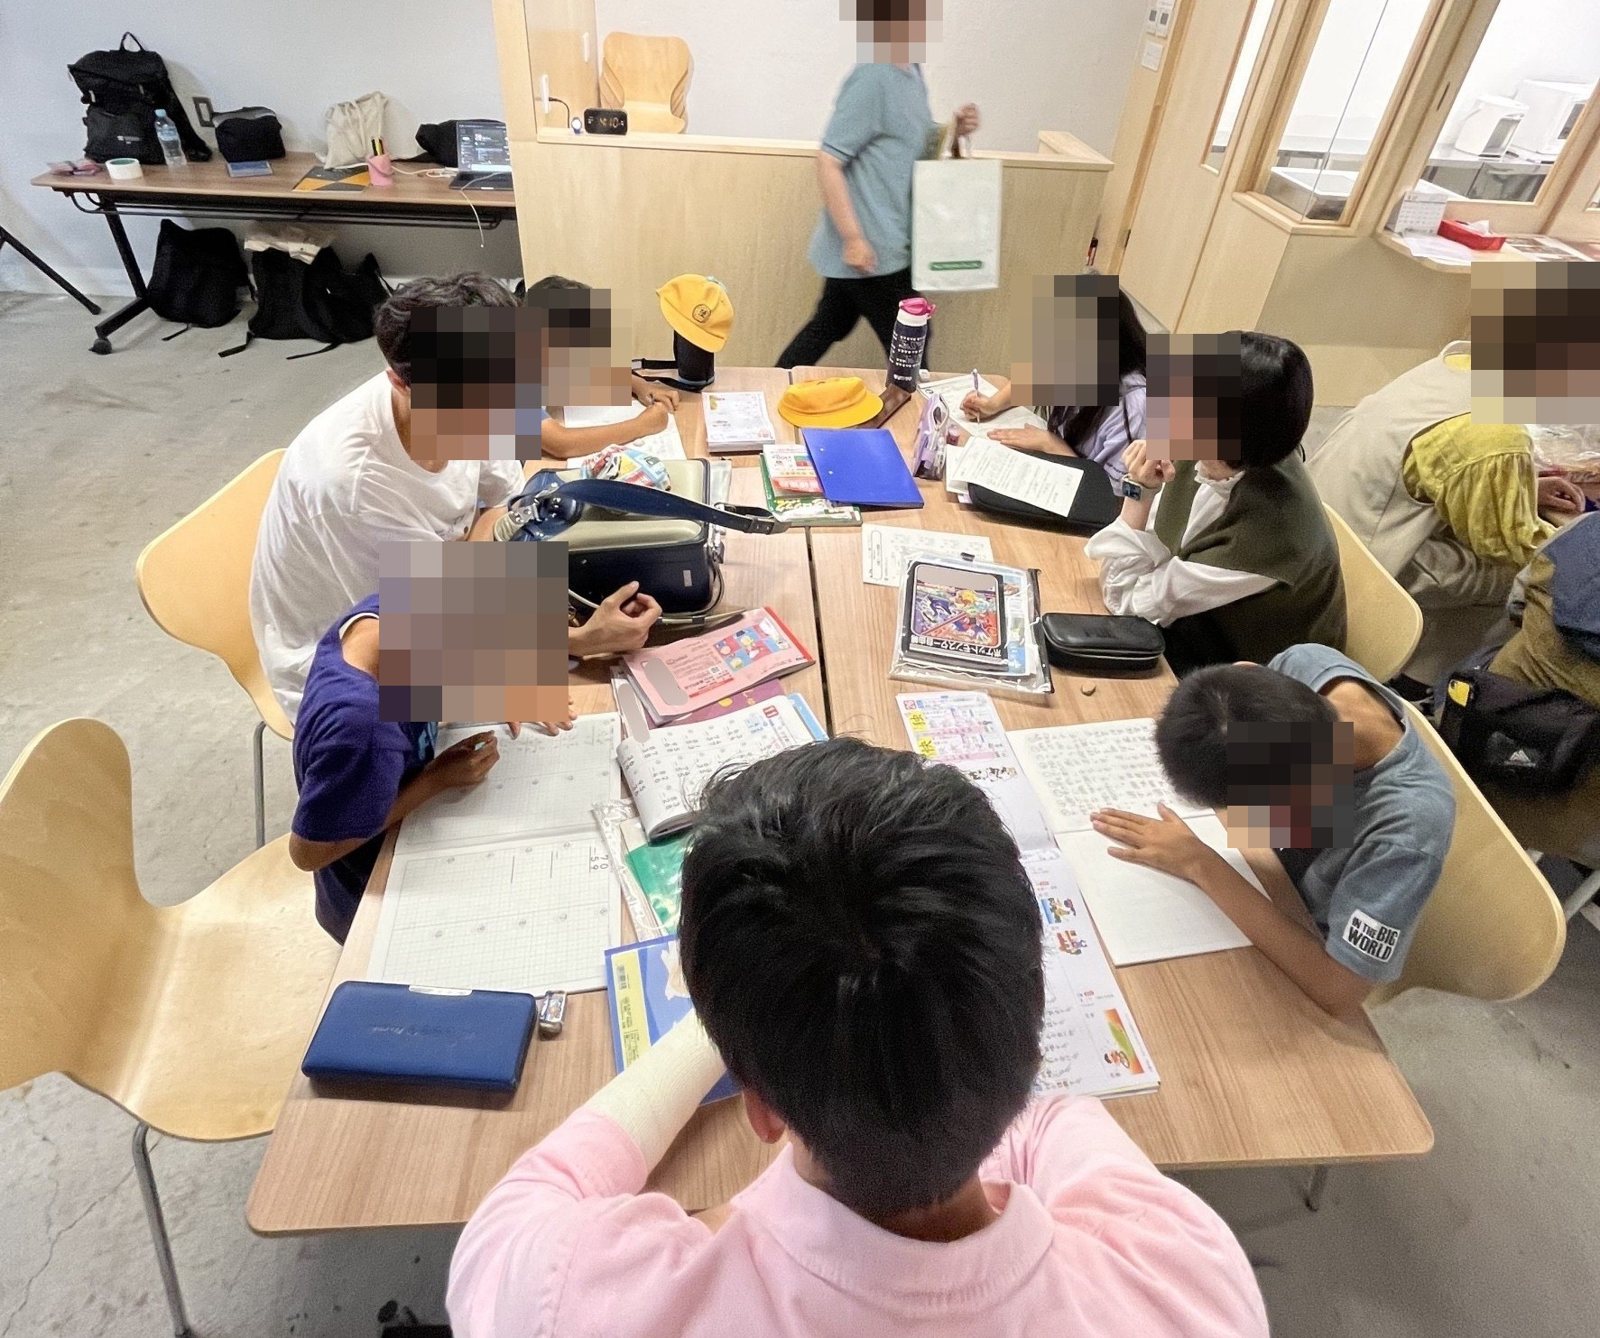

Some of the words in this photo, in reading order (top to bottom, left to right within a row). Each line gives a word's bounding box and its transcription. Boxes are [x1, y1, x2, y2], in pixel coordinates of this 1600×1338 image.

[1348, 927, 1392, 960] WORLD
[1352, 917, 1362, 929] IN
[1363, 923, 1377, 938] THE
[1377, 926, 1398, 946] BIG
